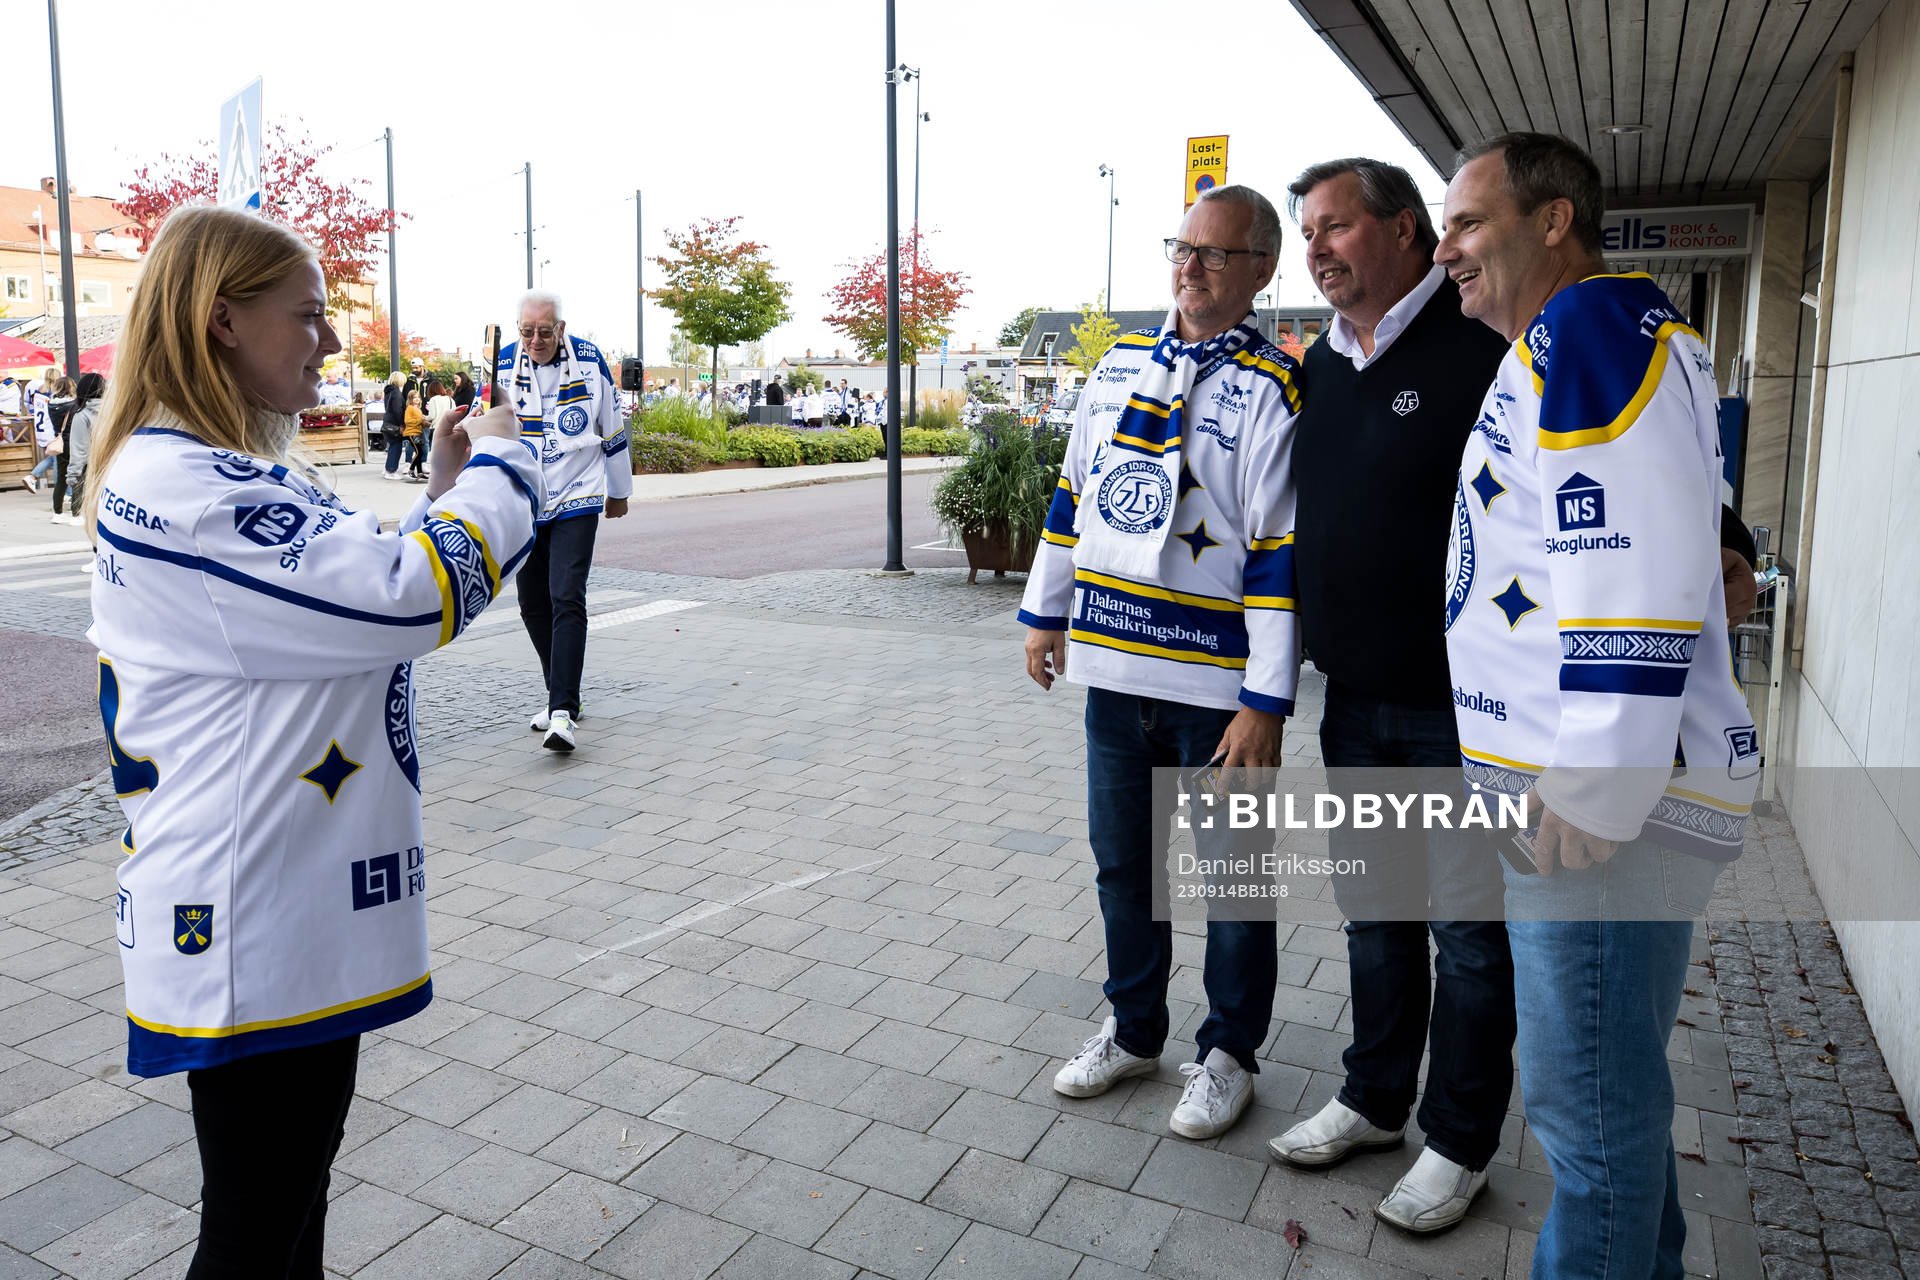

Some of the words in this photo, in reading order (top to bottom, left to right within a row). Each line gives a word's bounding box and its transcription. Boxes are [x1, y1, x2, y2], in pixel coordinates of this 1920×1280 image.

[1192, 143, 1222, 153] Last-
[1192, 156, 1221, 168] plats
[1602, 218, 1666, 250] ells
[1670, 224, 1702, 235] BOK
[1707, 223, 1719, 233] &
[1669, 236, 1737, 248] KONTOR
[1110, 366, 1141, 376] Bergkvist
[1098, 464, 1128, 511] LEKSANDS
[1565, 496, 1596, 523] NS
[252, 505, 296, 544] NS
[1107, 517, 1154, 533] ISHOCKEY
[1545, 532, 1631, 555] Skoglunds
[1089, 590, 1152, 619] Dalarnas
[1086, 607, 1219, 650] Försäkringsbolag
